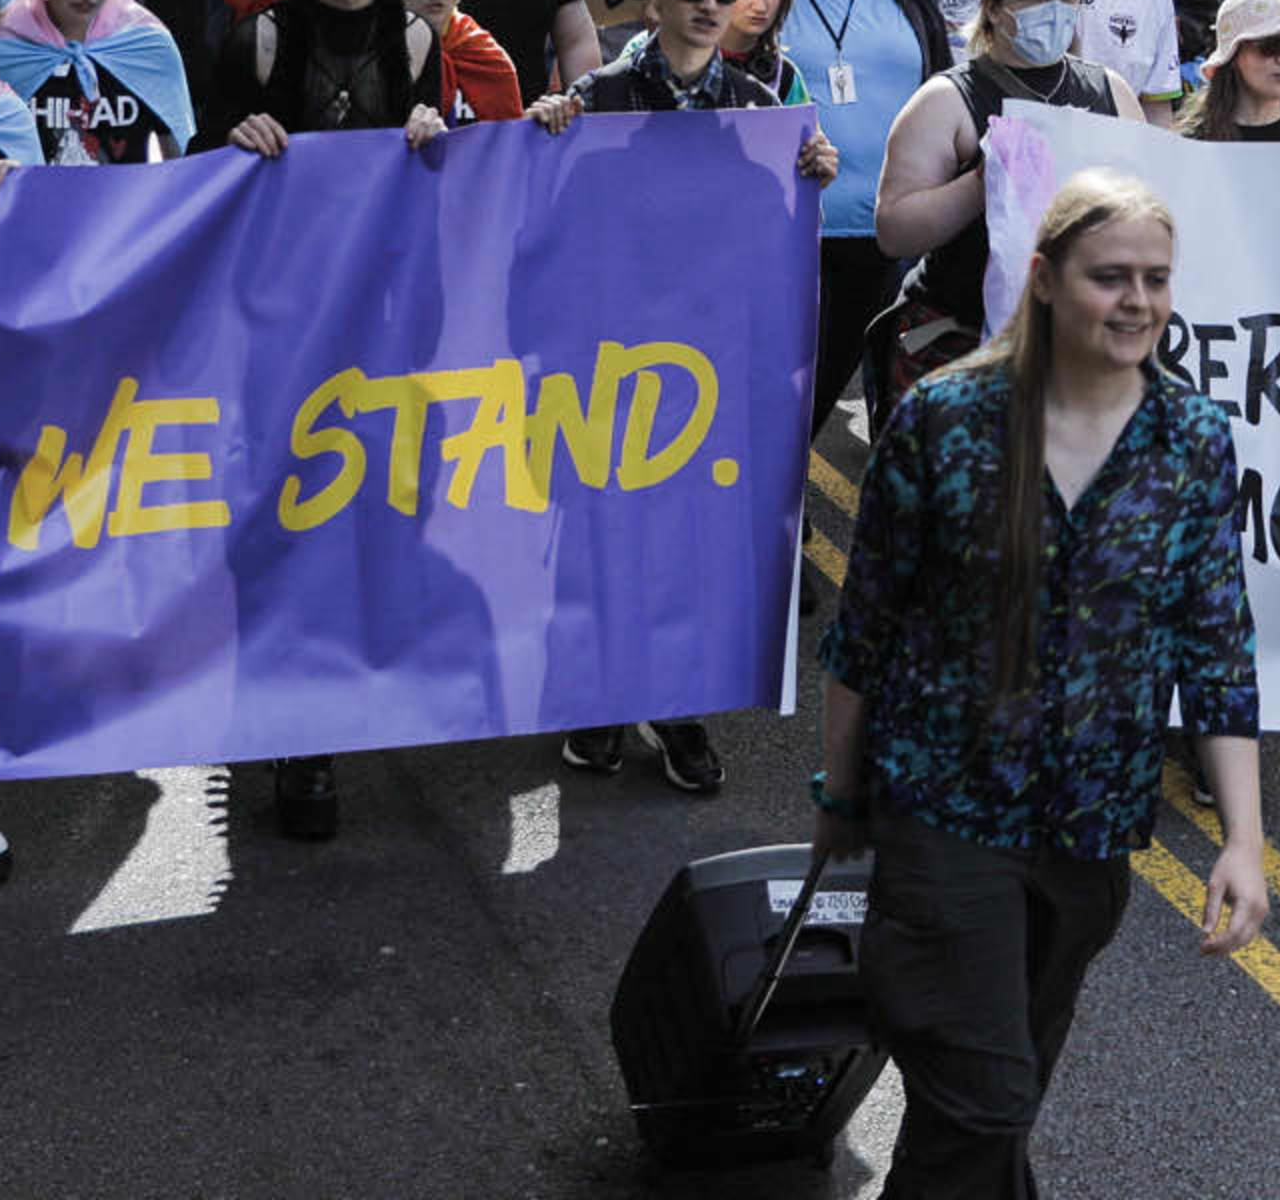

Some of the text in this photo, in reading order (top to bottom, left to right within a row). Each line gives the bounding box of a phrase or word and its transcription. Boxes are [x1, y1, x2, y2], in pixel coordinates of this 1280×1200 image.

[29, 95, 140, 129] HIHAD
[7, 376, 231, 550] WE
[278, 341, 739, 532] STAND.
